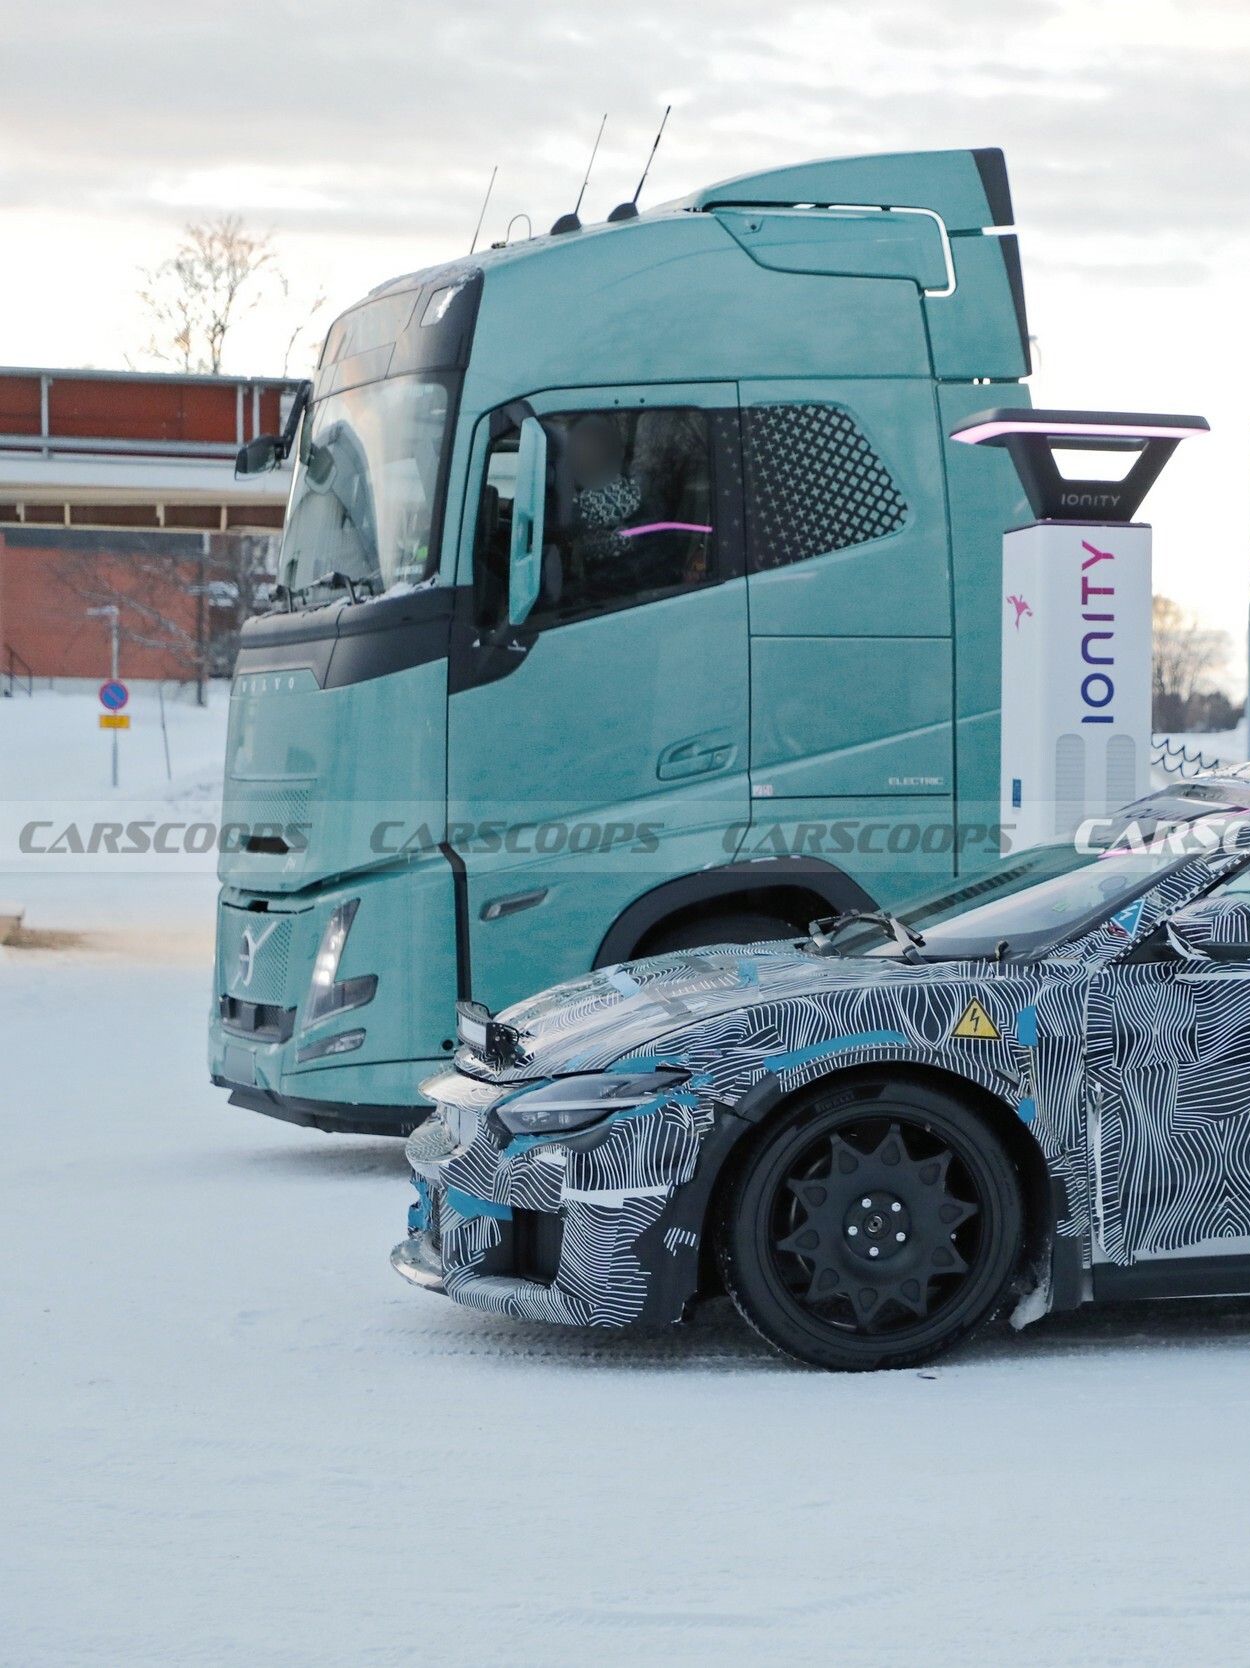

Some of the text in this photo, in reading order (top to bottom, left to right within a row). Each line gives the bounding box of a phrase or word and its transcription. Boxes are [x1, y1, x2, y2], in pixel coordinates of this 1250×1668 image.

[1061, 494, 1121, 506] IONITY
[1081, 540, 1115, 723] IONITY
[888, 777, 943, 786] ELECTRIC
